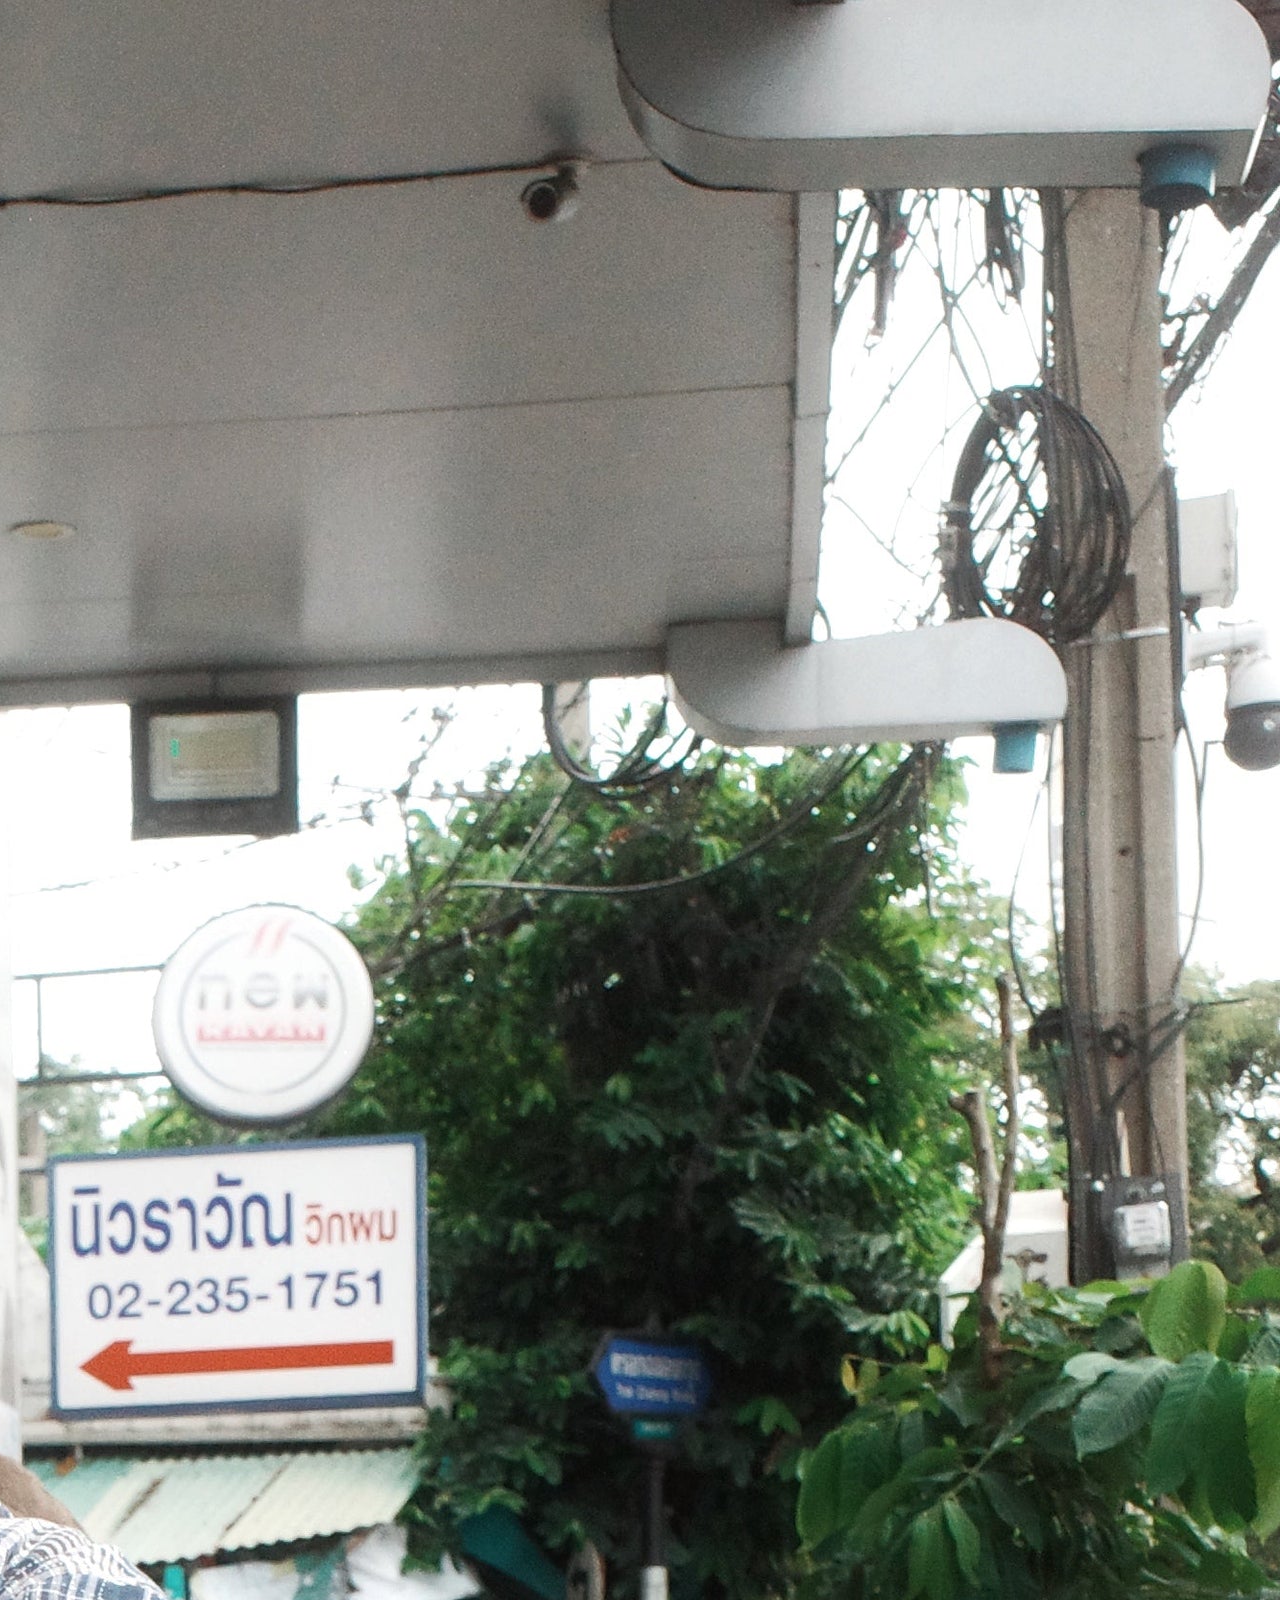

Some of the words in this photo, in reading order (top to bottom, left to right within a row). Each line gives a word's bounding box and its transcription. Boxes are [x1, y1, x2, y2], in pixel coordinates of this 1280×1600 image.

[71, 1172, 293, 1257] นิวราวัณ
[304, 1204, 398, 1247] วิกผม
[87, 1269, 385, 1320] 02-235-1751
